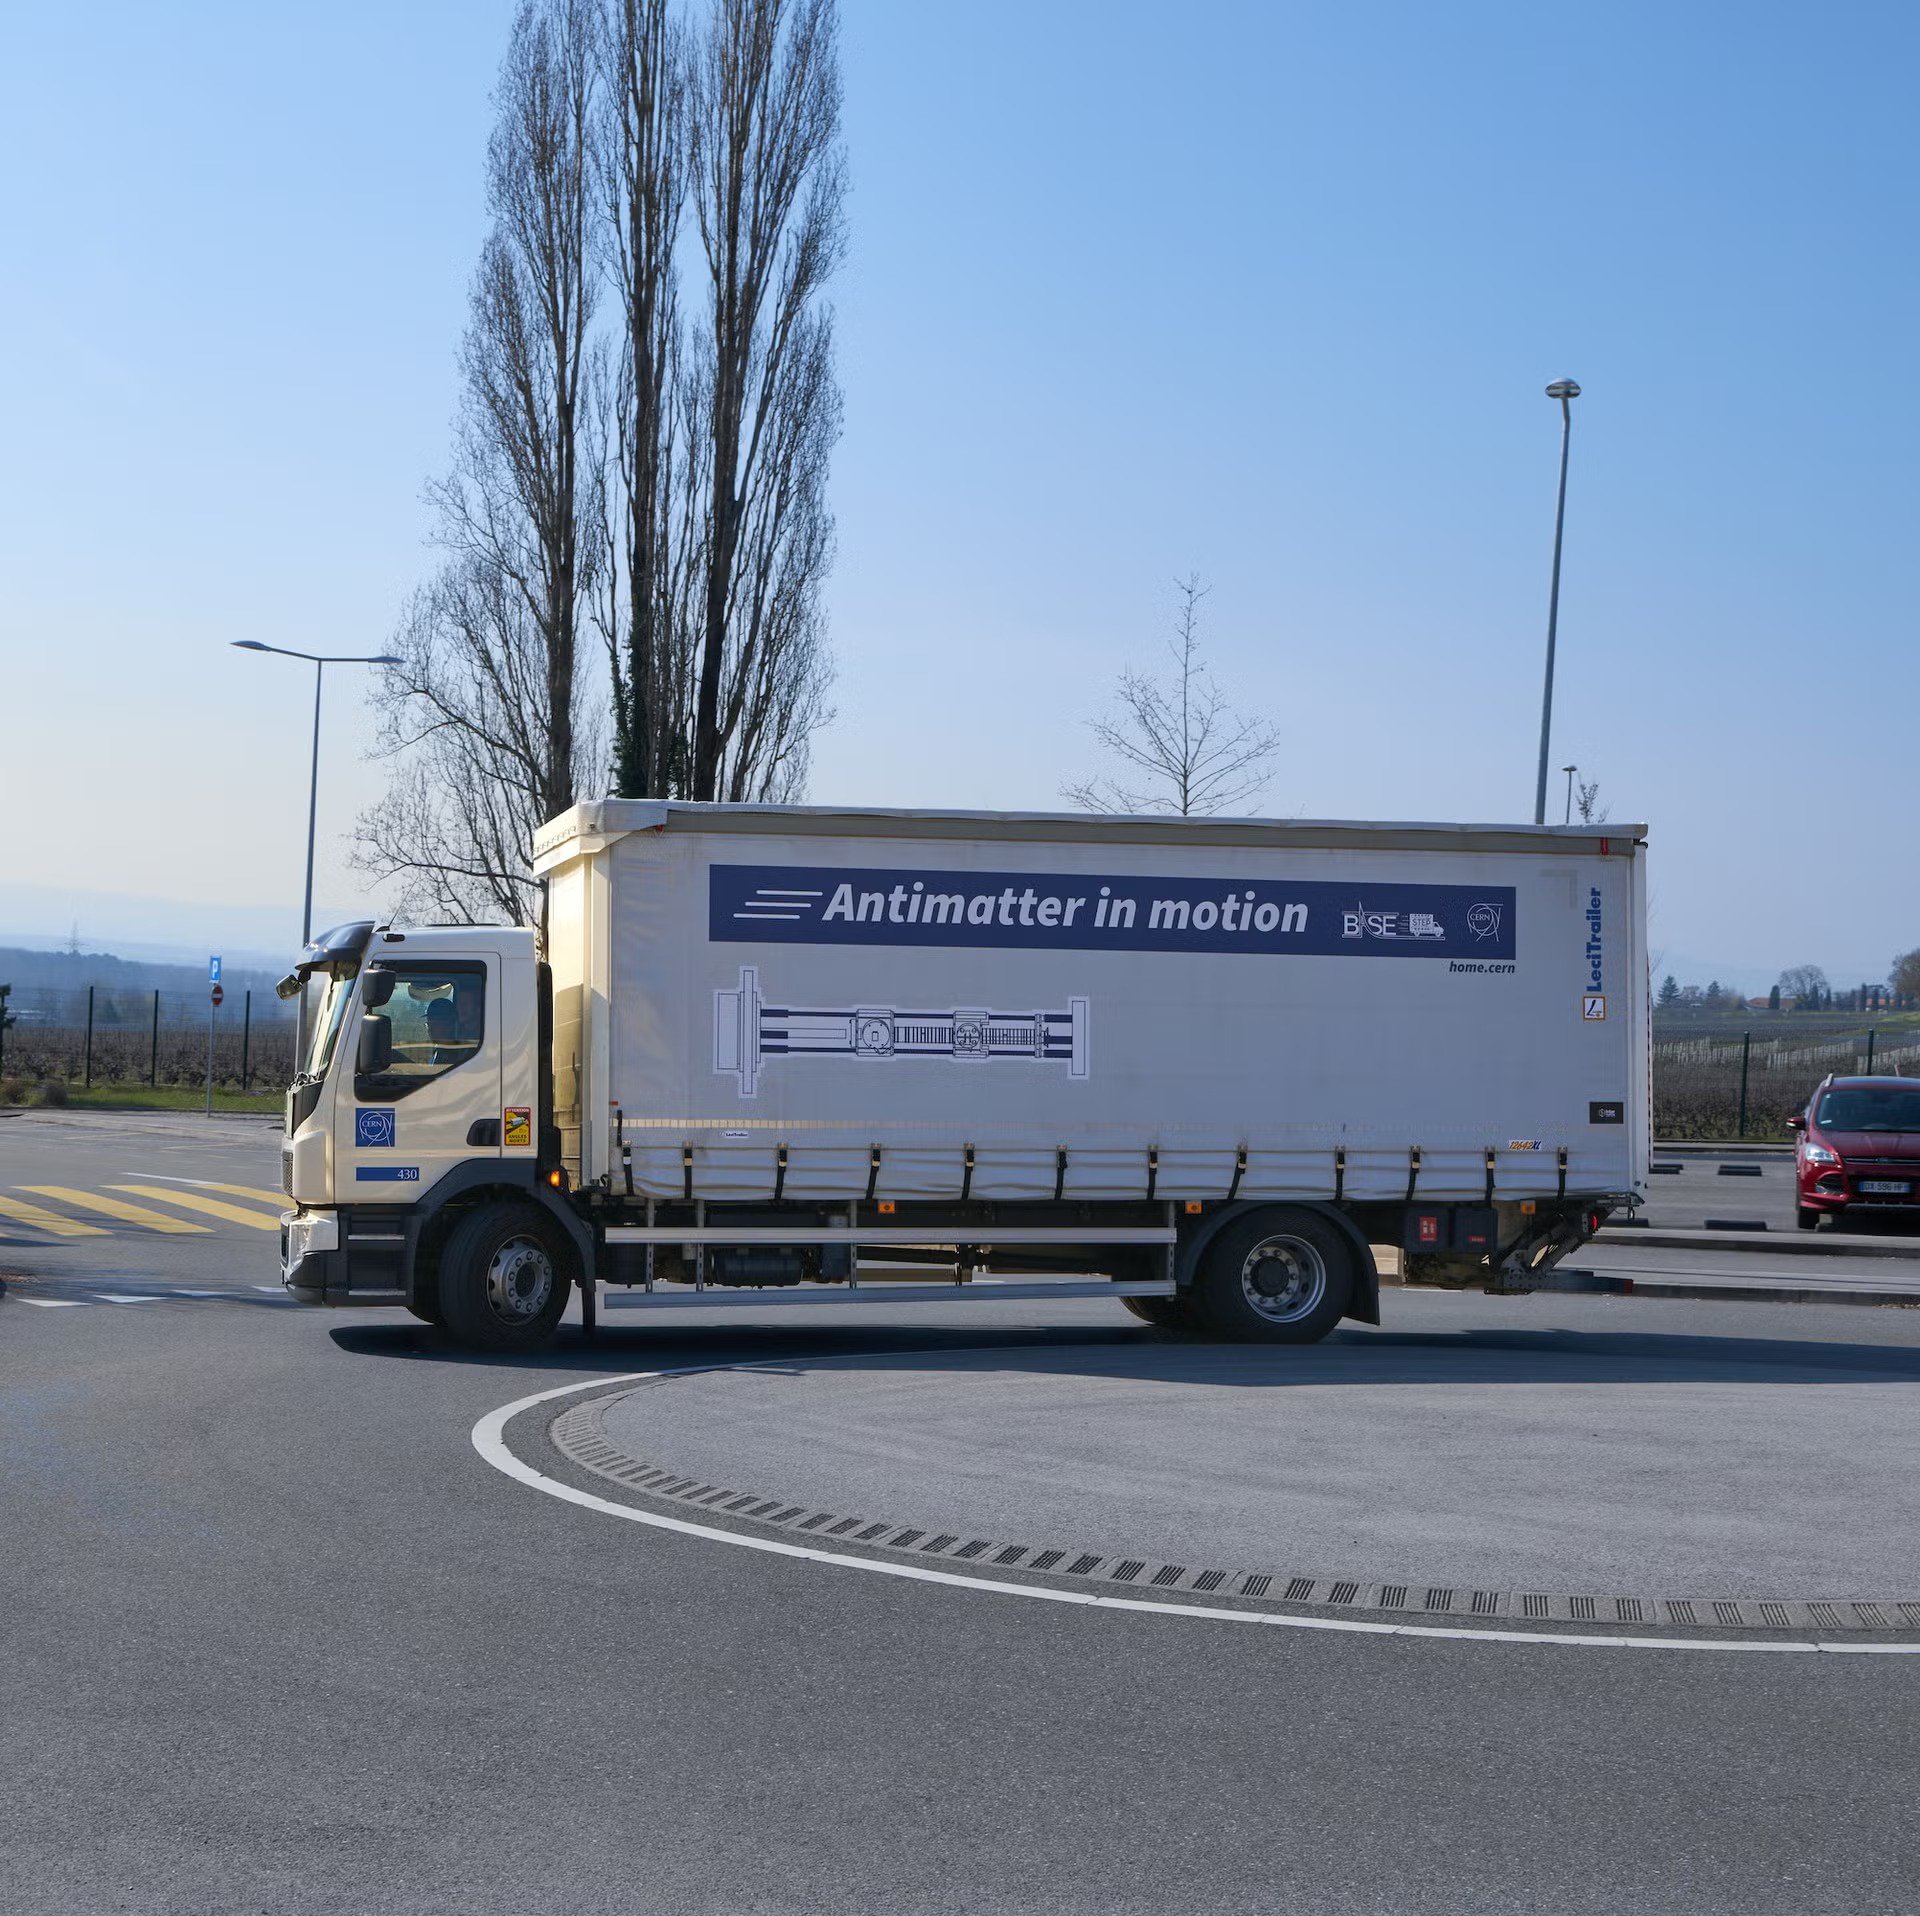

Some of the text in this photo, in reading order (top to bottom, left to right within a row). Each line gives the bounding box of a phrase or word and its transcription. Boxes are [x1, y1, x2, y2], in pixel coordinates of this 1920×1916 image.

[822, 881, 1309, 933] Antimatter in motion
[1470, 912, 1490, 922] CERN
[1586, 887, 1602, 992] LeciTrailer
[1449, 960, 1516, 974] home.cern
[362, 1120, 382, 1128] CERN
[397, 1169, 417, 1180] 430
